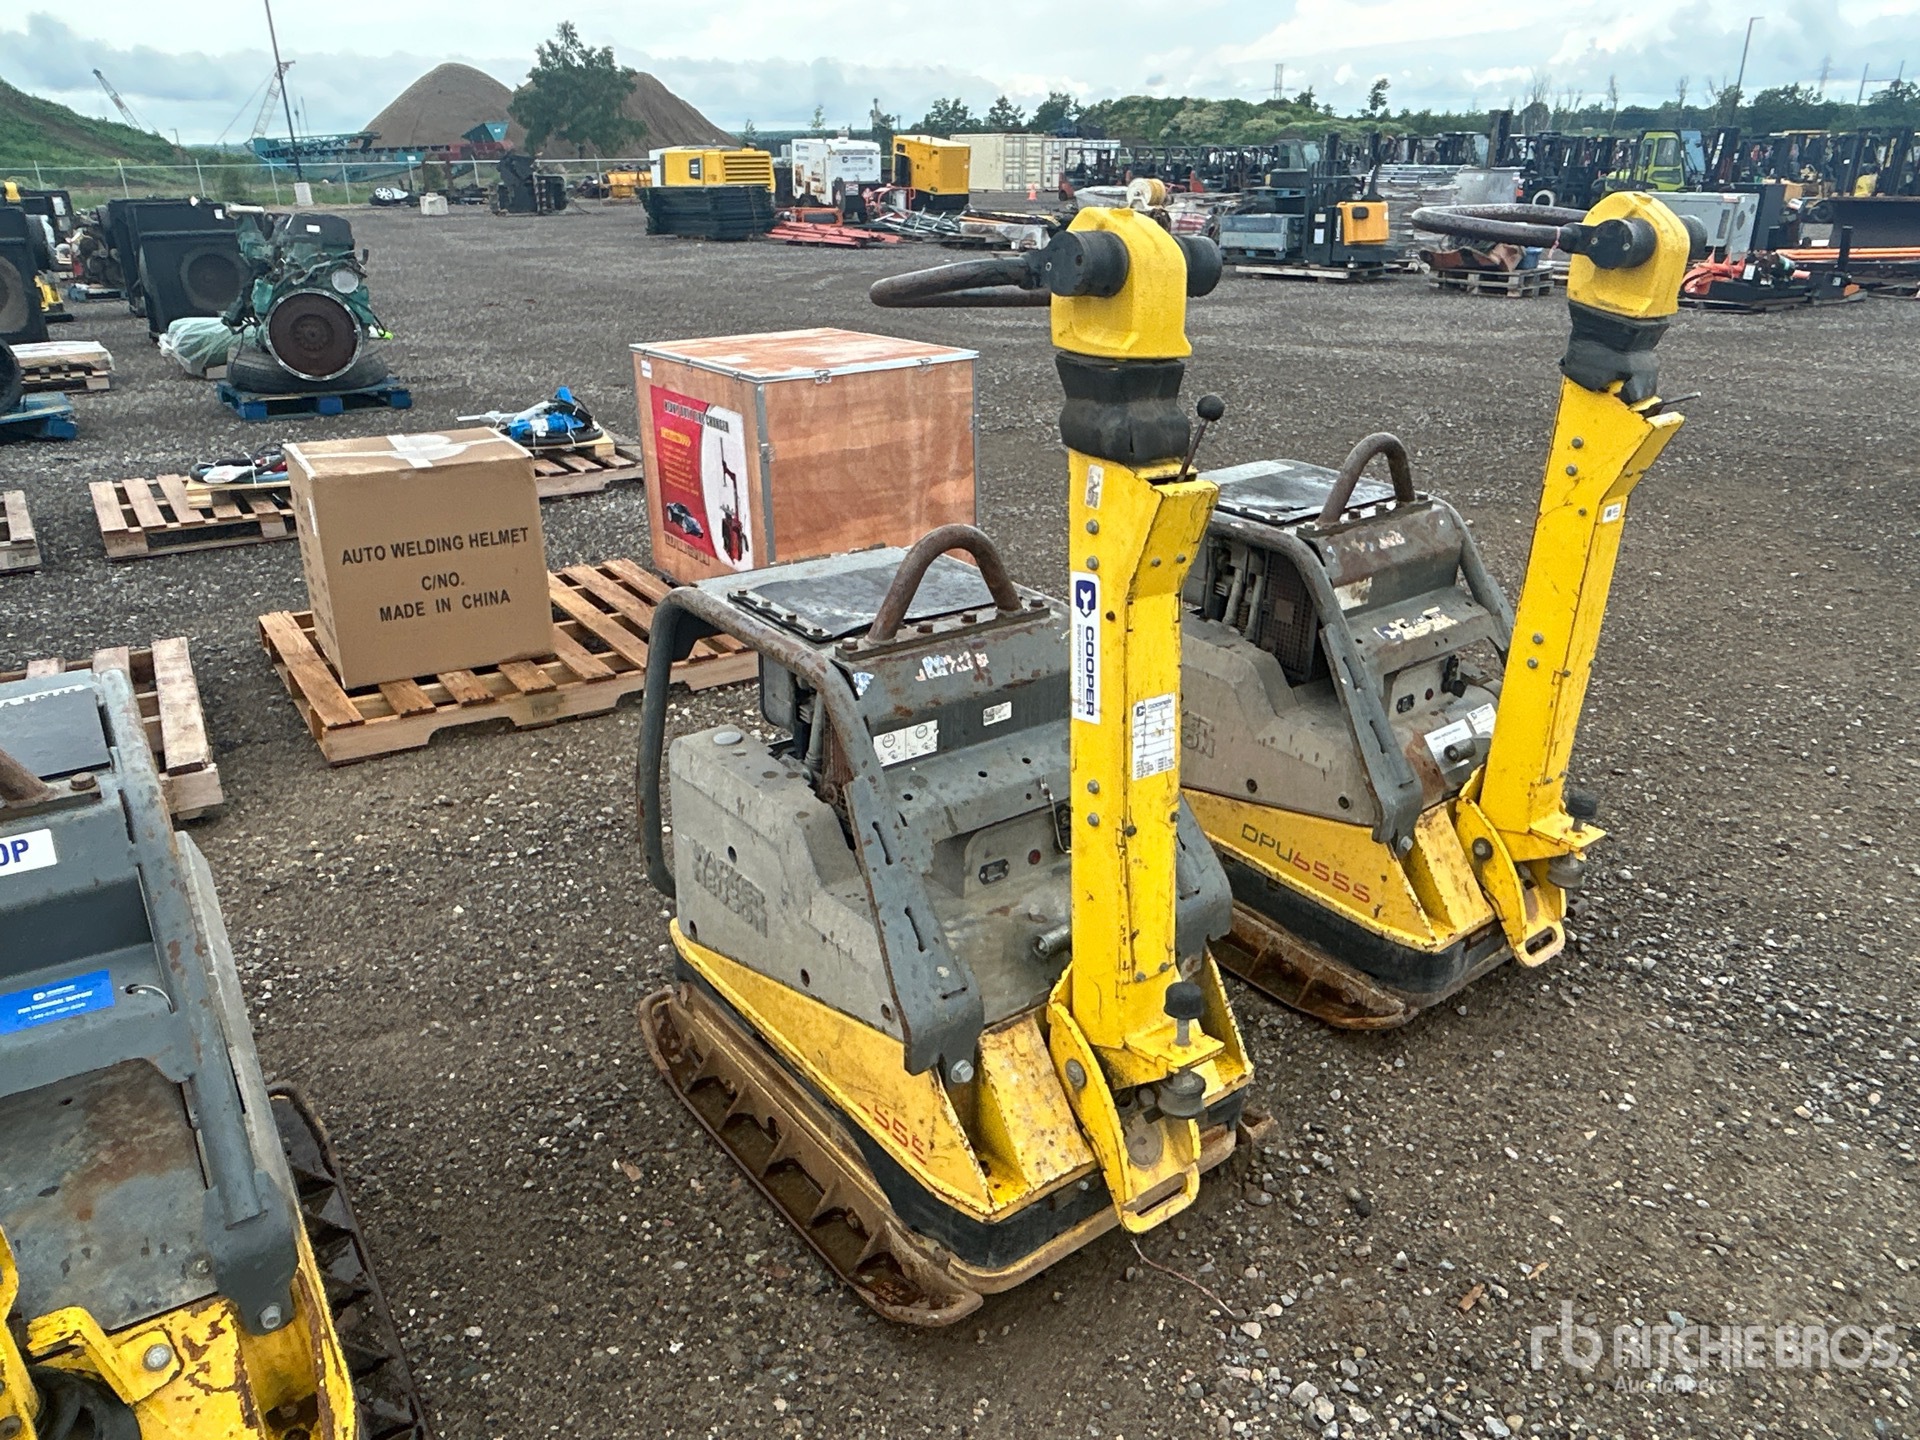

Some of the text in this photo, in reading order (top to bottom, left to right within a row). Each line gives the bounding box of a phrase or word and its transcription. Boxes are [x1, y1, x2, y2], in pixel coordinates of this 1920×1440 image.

[342, 527, 529, 565] AUTO WELDING HELMET
[421, 572, 465, 591] C/NO.
[379, 589, 511, 622] MADE IN CHINA
[1085, 625, 1095, 717] COOPER
